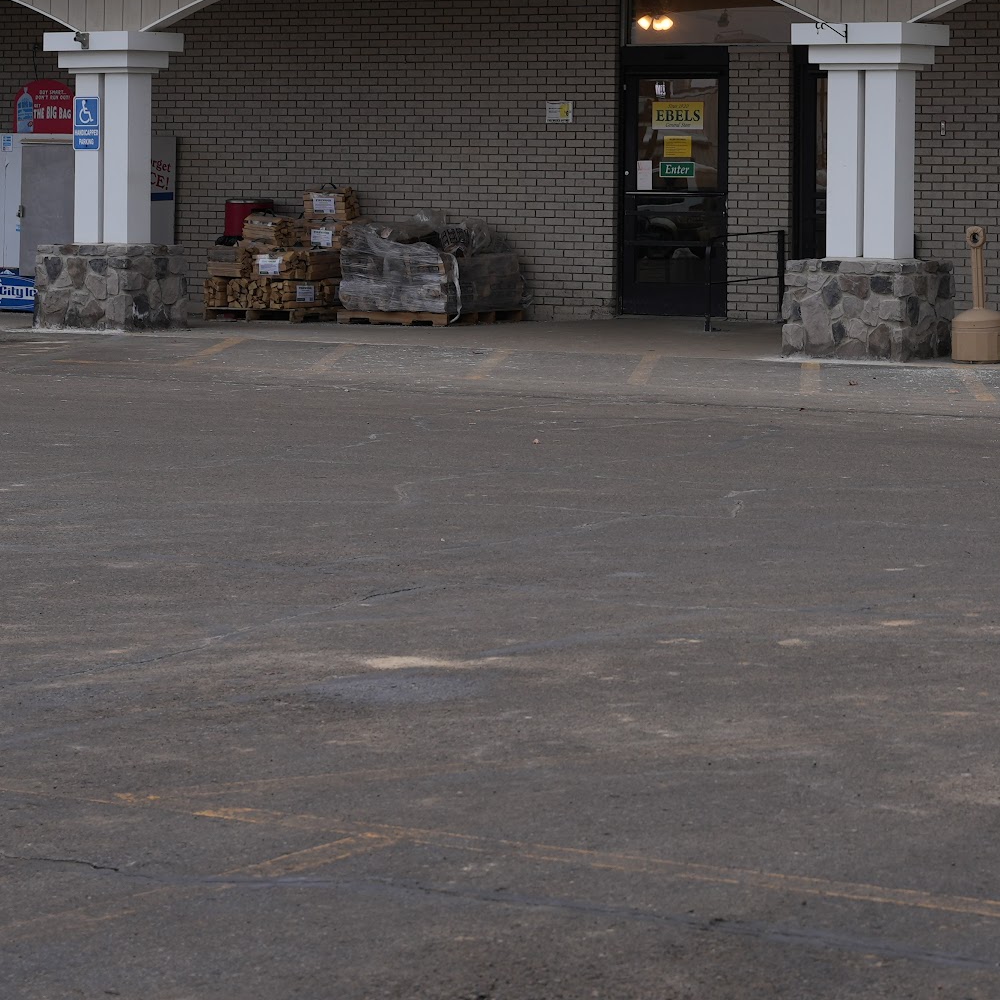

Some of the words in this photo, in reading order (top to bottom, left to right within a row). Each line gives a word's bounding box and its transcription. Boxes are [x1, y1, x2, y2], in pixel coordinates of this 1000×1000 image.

[33, 107, 45, 119] THE
[46, 106, 57, 119] BIG
[58, 107, 72, 119] BAG
[655, 109, 701, 122] EBELS
[151, 159, 172, 172] rget
[665, 164, 690, 175] Enter
[0, 286, 23, 298] City
[25, 287, 37, 297] Ic
